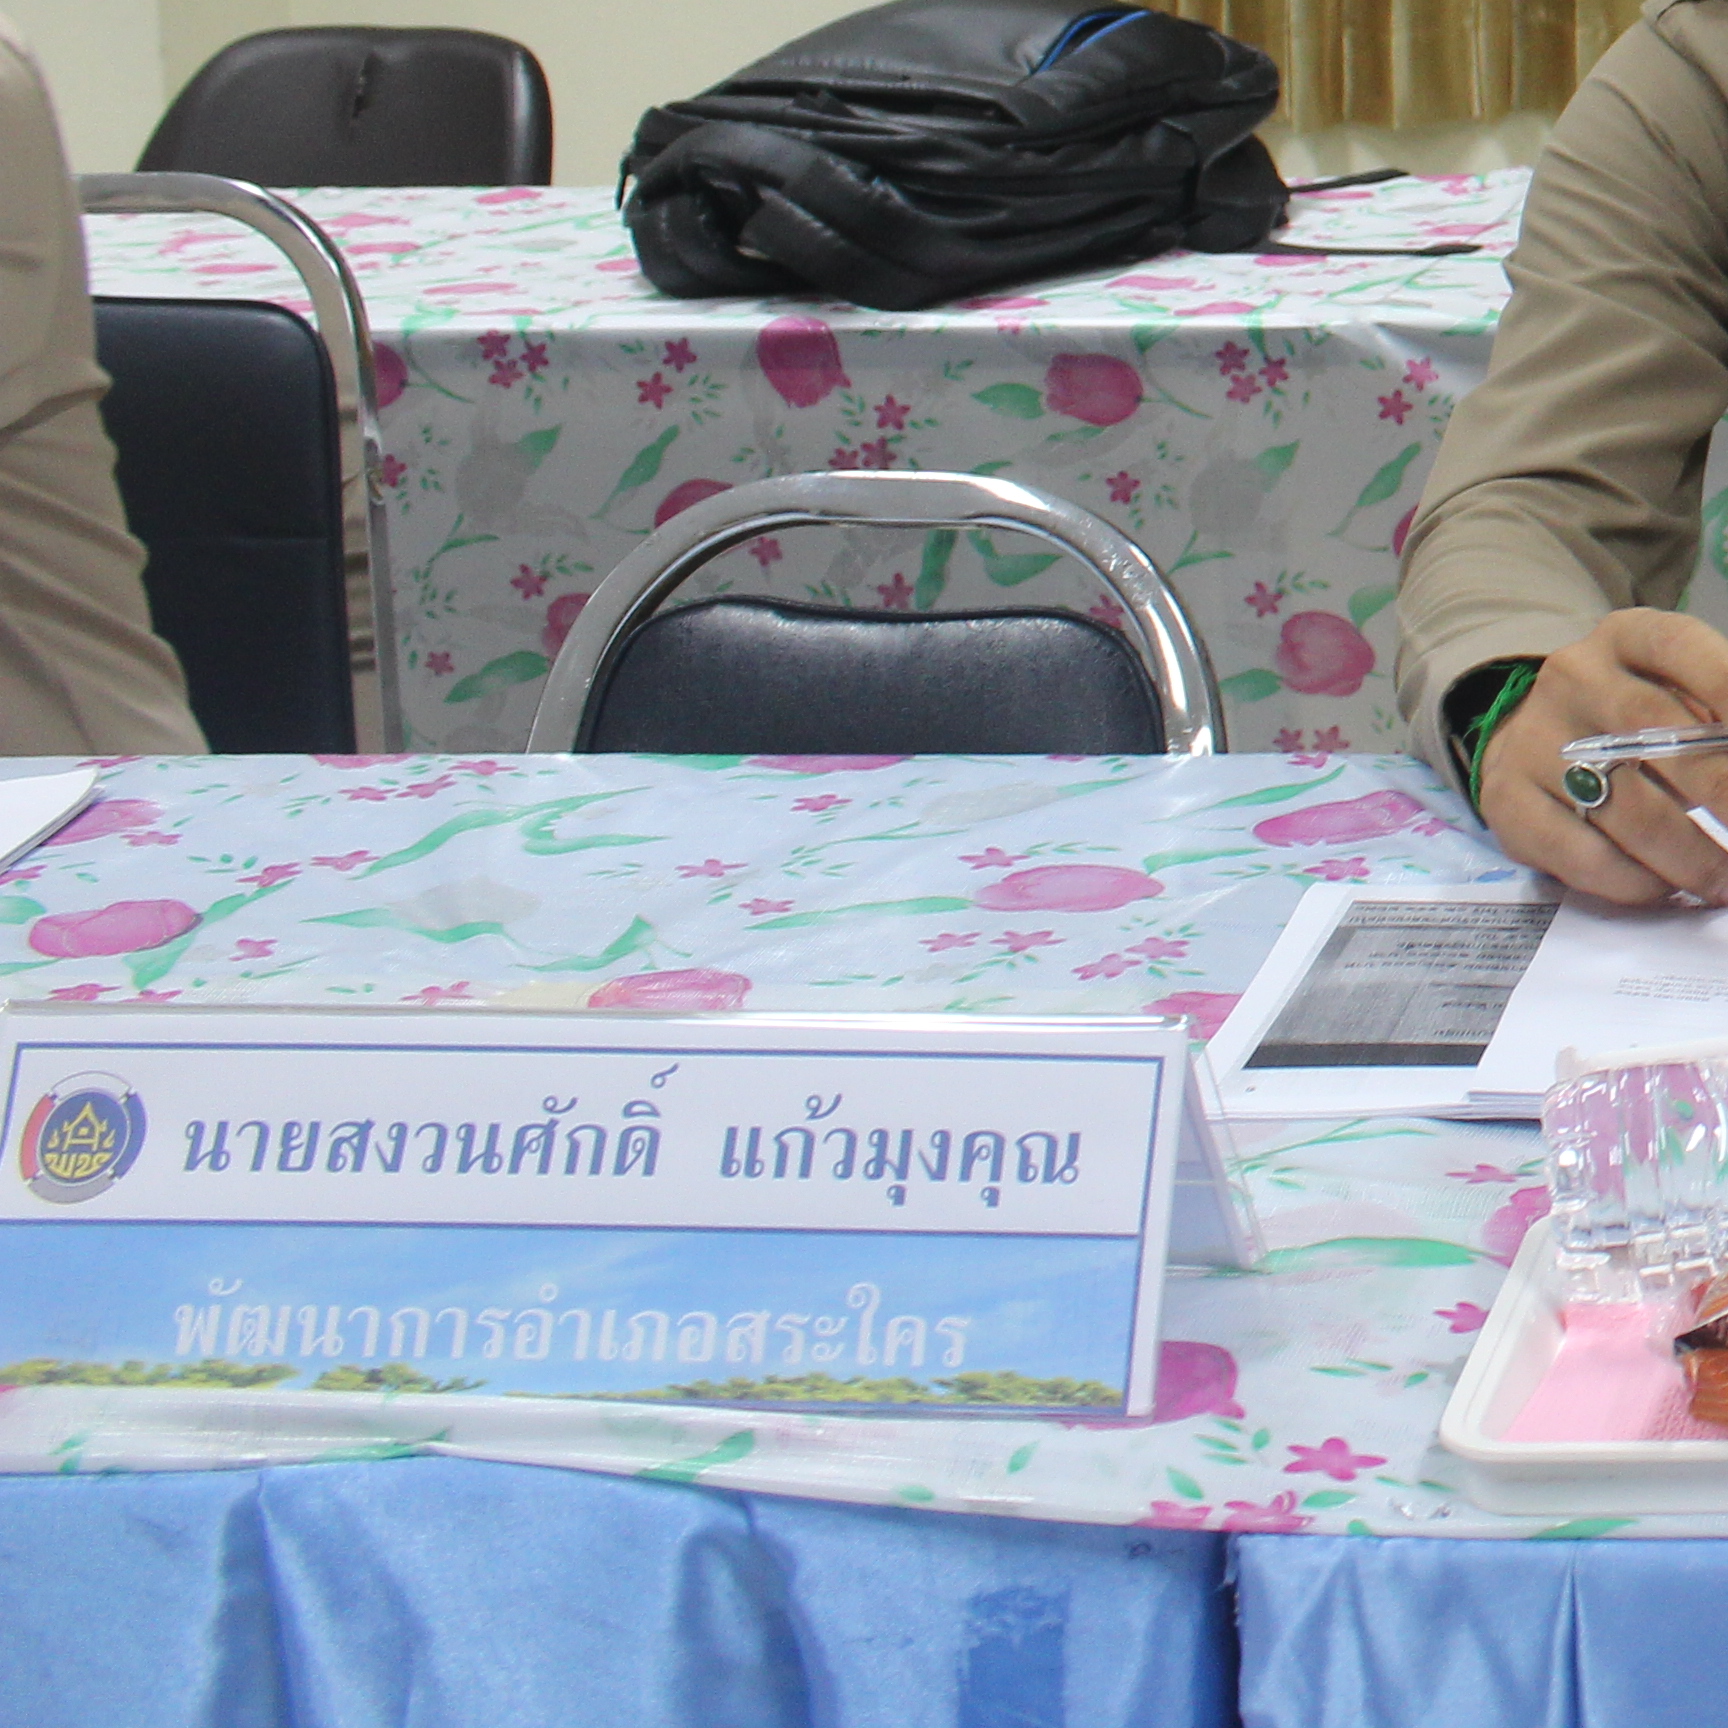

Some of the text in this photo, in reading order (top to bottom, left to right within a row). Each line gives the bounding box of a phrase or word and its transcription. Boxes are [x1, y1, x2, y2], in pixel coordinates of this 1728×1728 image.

[182, 1062, 1083, 1208] นายสงวนศักดิ์ แก้วมุงคุณ
[174, 1277, 972, 1369] พัฒนาการอำเภอสระใคร
